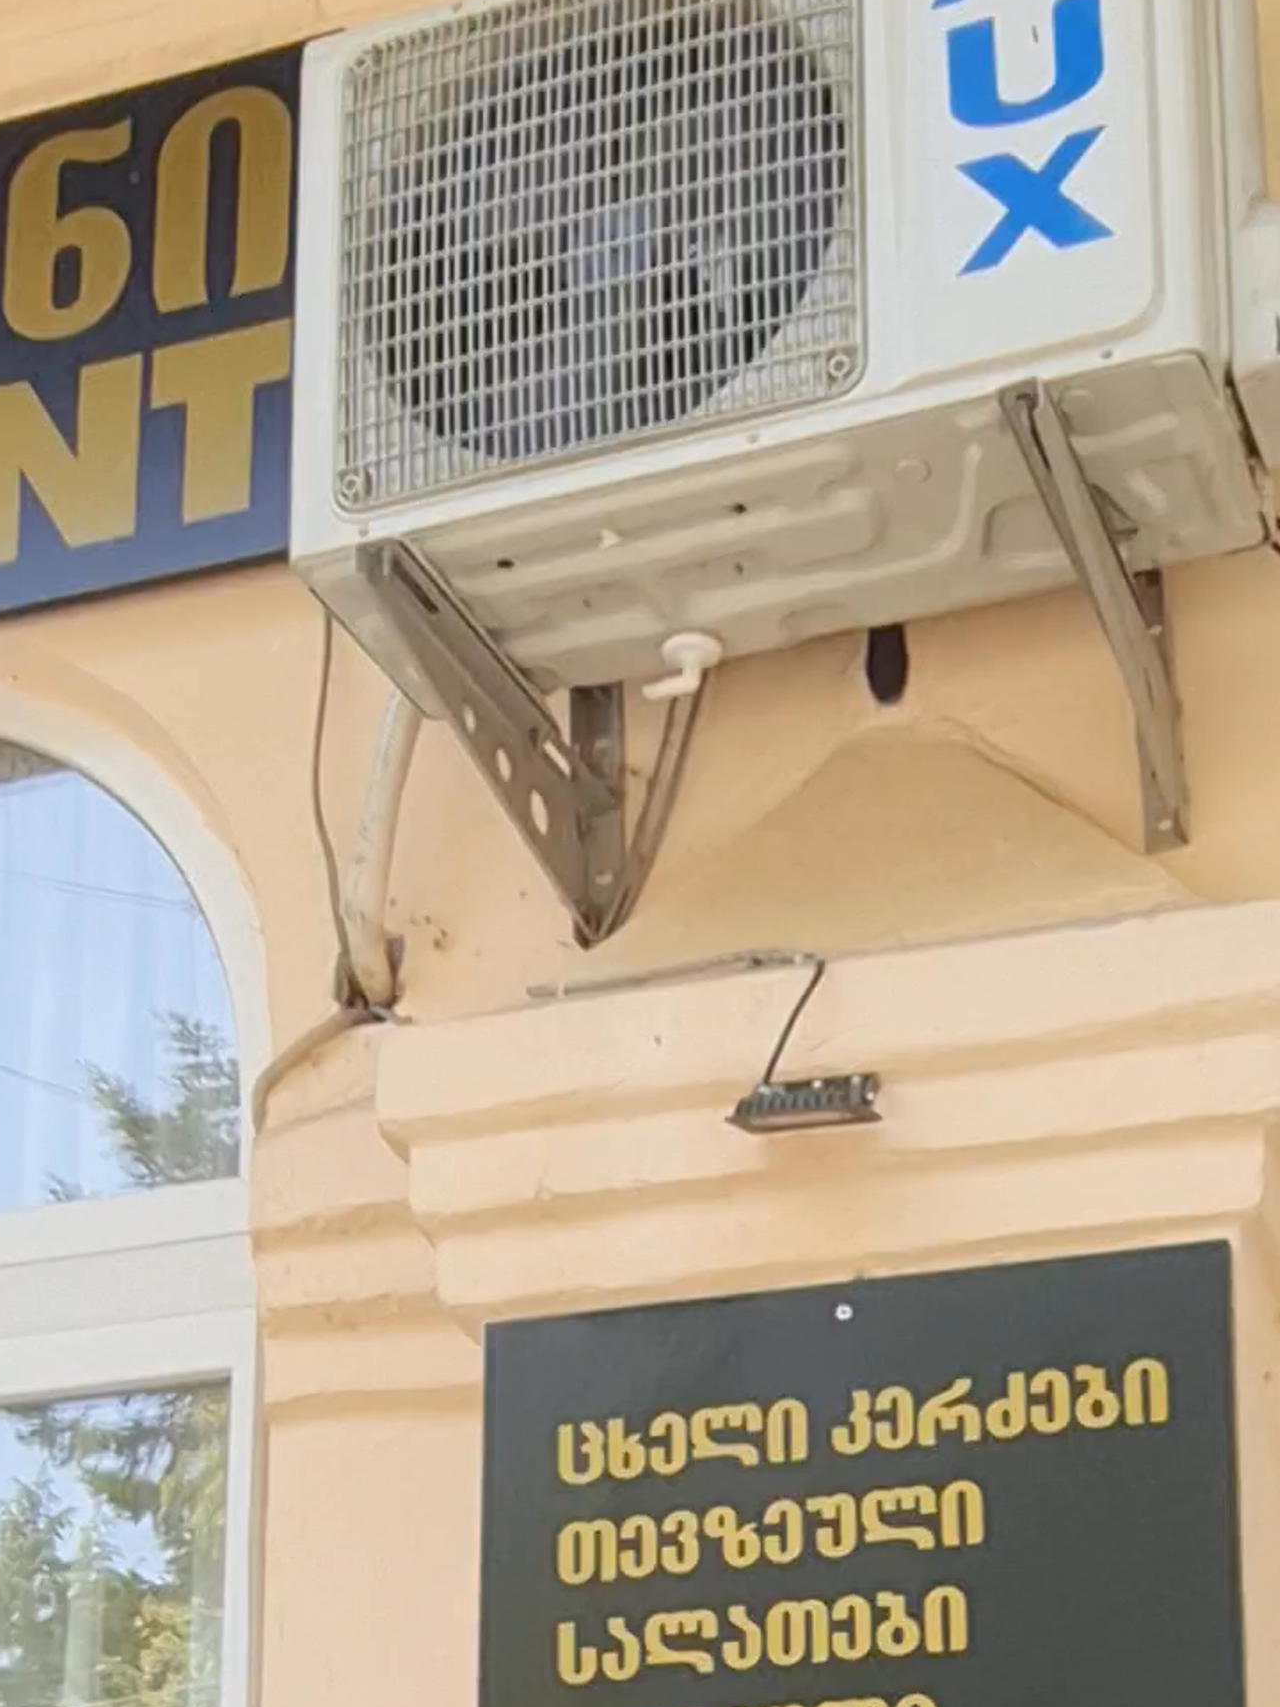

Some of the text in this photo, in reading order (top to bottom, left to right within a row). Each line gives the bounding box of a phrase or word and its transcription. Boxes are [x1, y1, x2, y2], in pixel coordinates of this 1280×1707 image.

[556, 1357, 1169, 1486] ცხელი კერძები
[556, 1480, 986, 1585] თევზეული
[555, 1585, 969, 1685] სალათები
